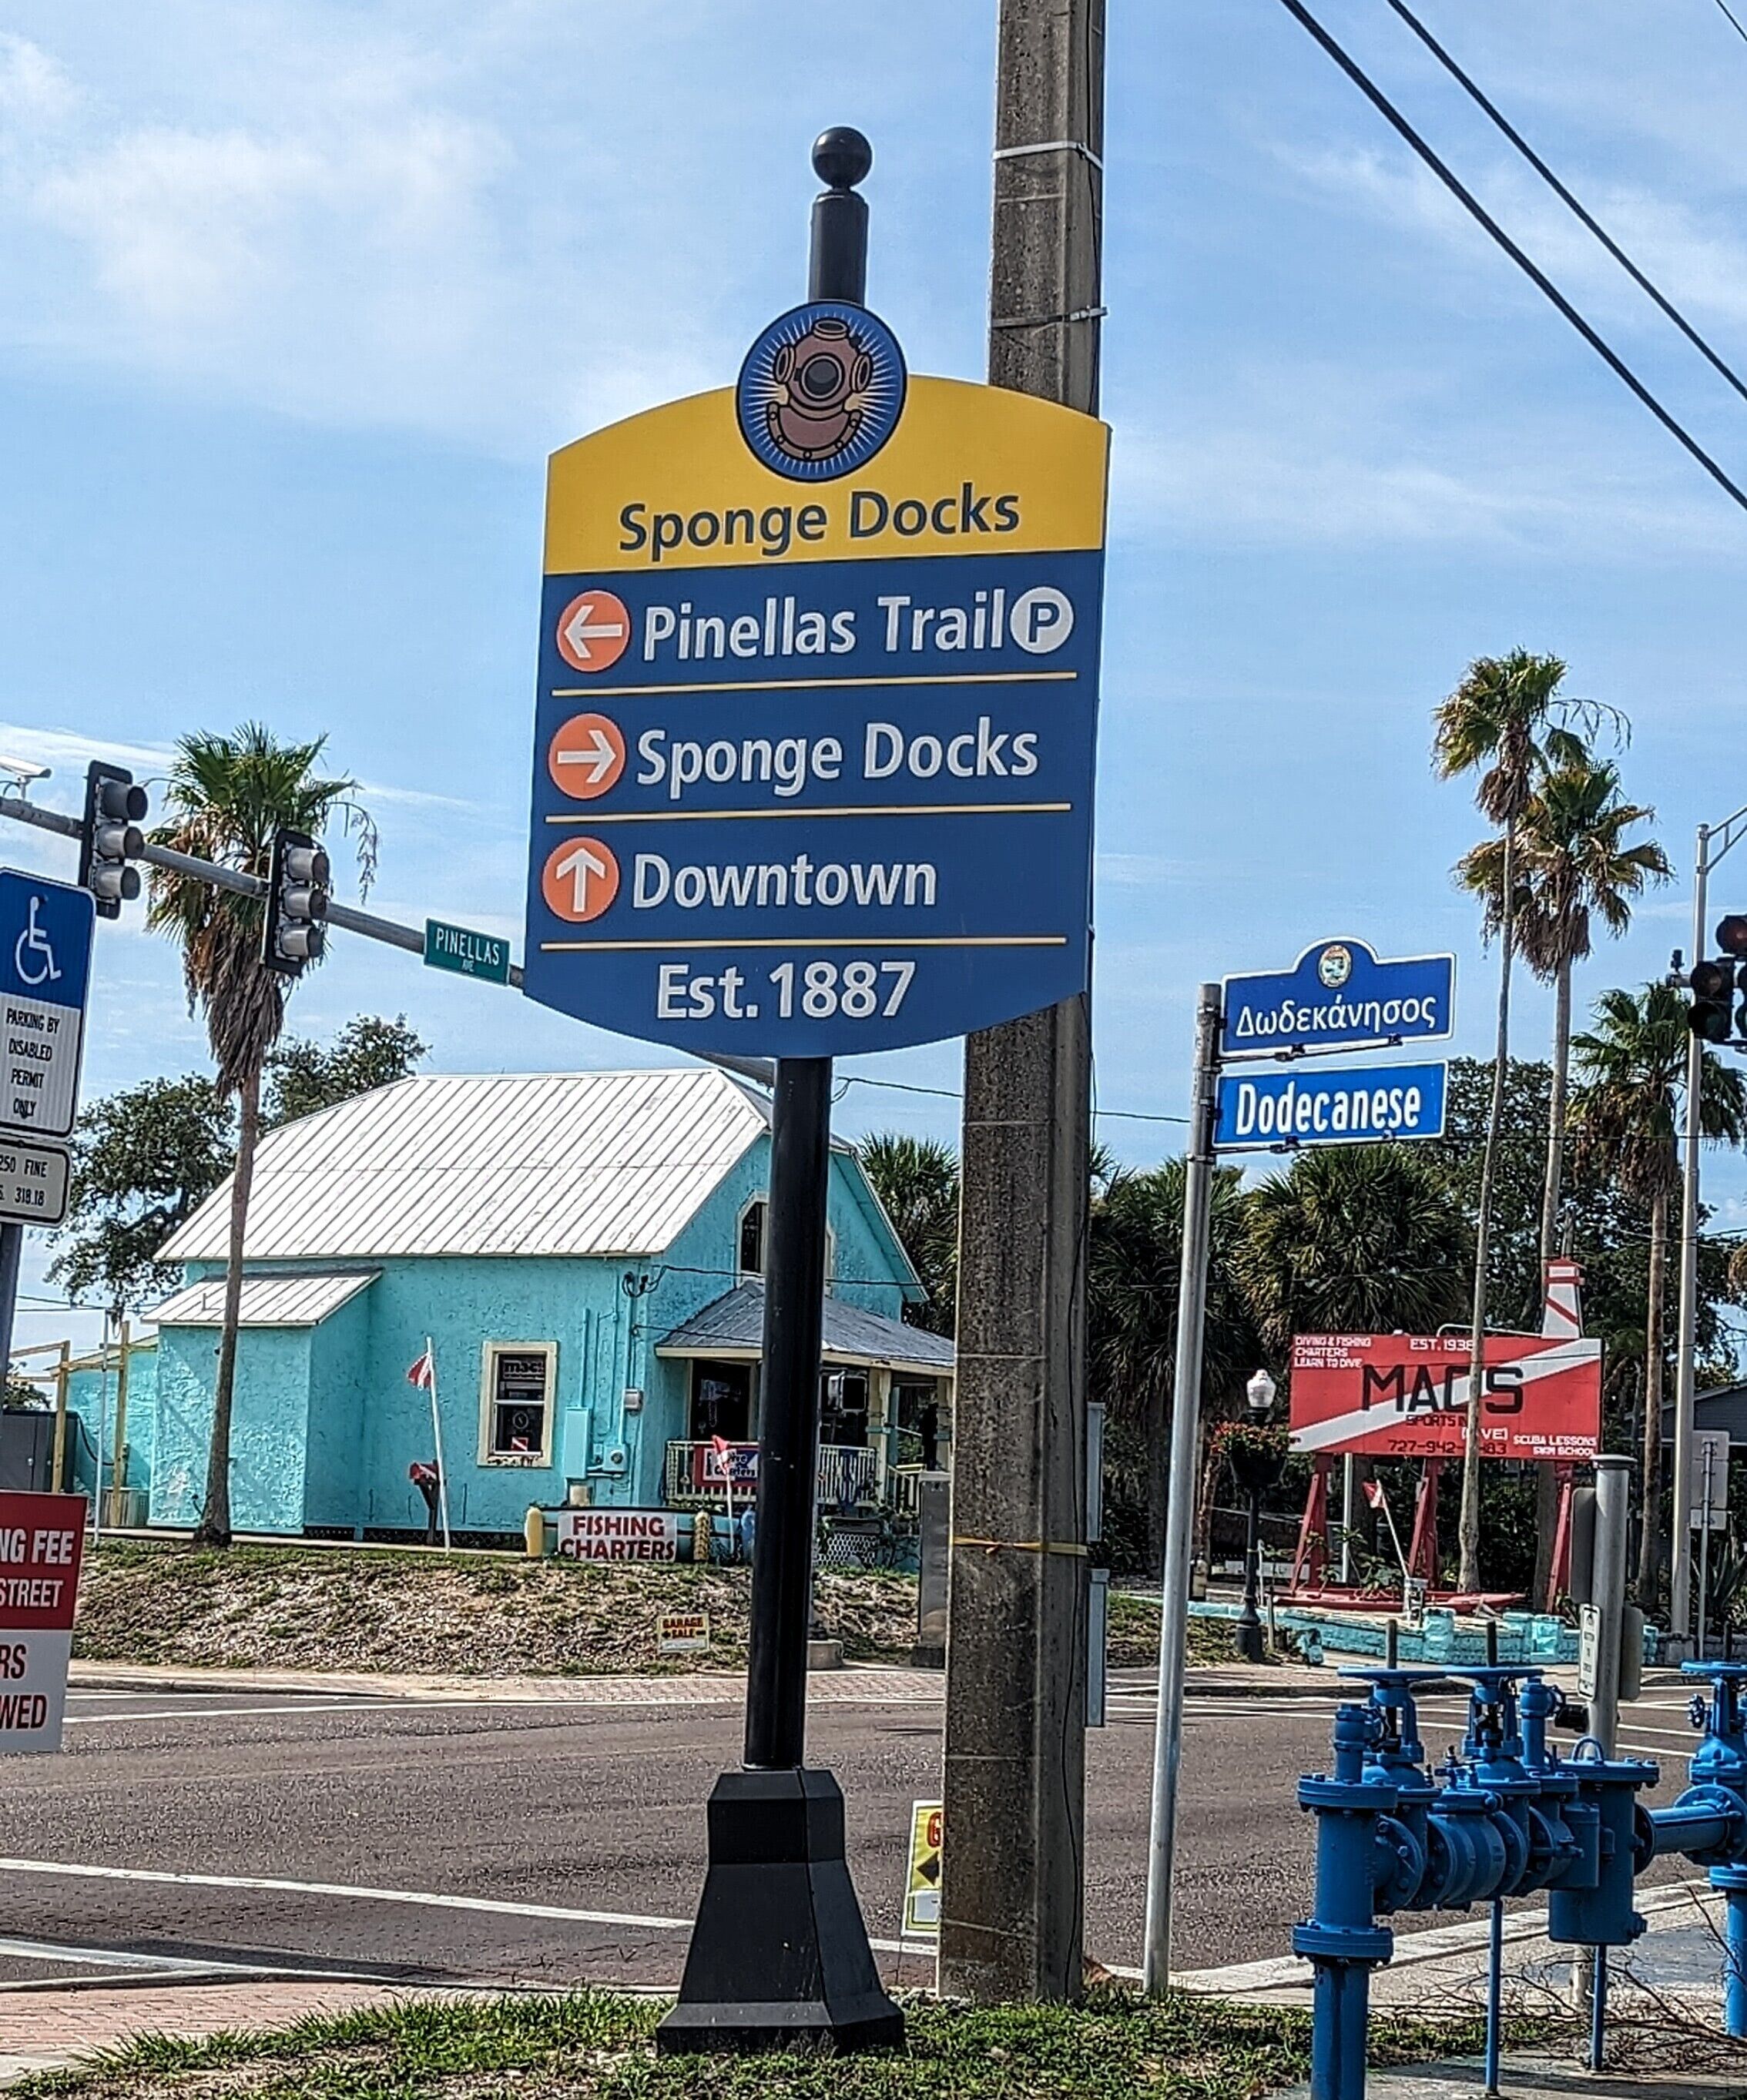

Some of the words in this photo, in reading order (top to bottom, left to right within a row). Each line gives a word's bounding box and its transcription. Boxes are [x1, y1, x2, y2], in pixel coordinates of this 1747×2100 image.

[619, 502, 827, 561] Sponge
[850, 483, 1020, 538] Docks
[642, 597, 856, 661] Pinellas
[877, 588, 1005, 652] Trail
[637, 728, 842, 799] Sponge
[863, 717, 1039, 777] Docks
[632, 853, 937, 909] Downtown
[436, 926, 500, 966] PINELLAS
[657, 964, 758, 1019] Est.
[769, 961, 915, 1018] 1887
[6, 1007, 45, 1031] PARKING
[47, 1017, 60, 1034] BY
[1236, 994, 1436, 1037] Δωδεκάνησος
[8, 1038, 52, 1062] DISABLED
[11, 1068, 45, 1089] PERMIT
[13, 1097, 37, 1119] ONLY
[1236, 1081, 1421, 1136] Dodecanese
[24, 1158, 48, 1178] FINE
[1294, 1357, 1324, 1368] LEARN
[1295, 1347, 1348, 1358] CHARTERS
[1406, 1415, 1456, 1426] SPORTS
[572, 1515, 665, 1537] FISHING
[32, 1529, 75, 1564] FEE
[560, 1538, 675, 1560] CHARTERS
